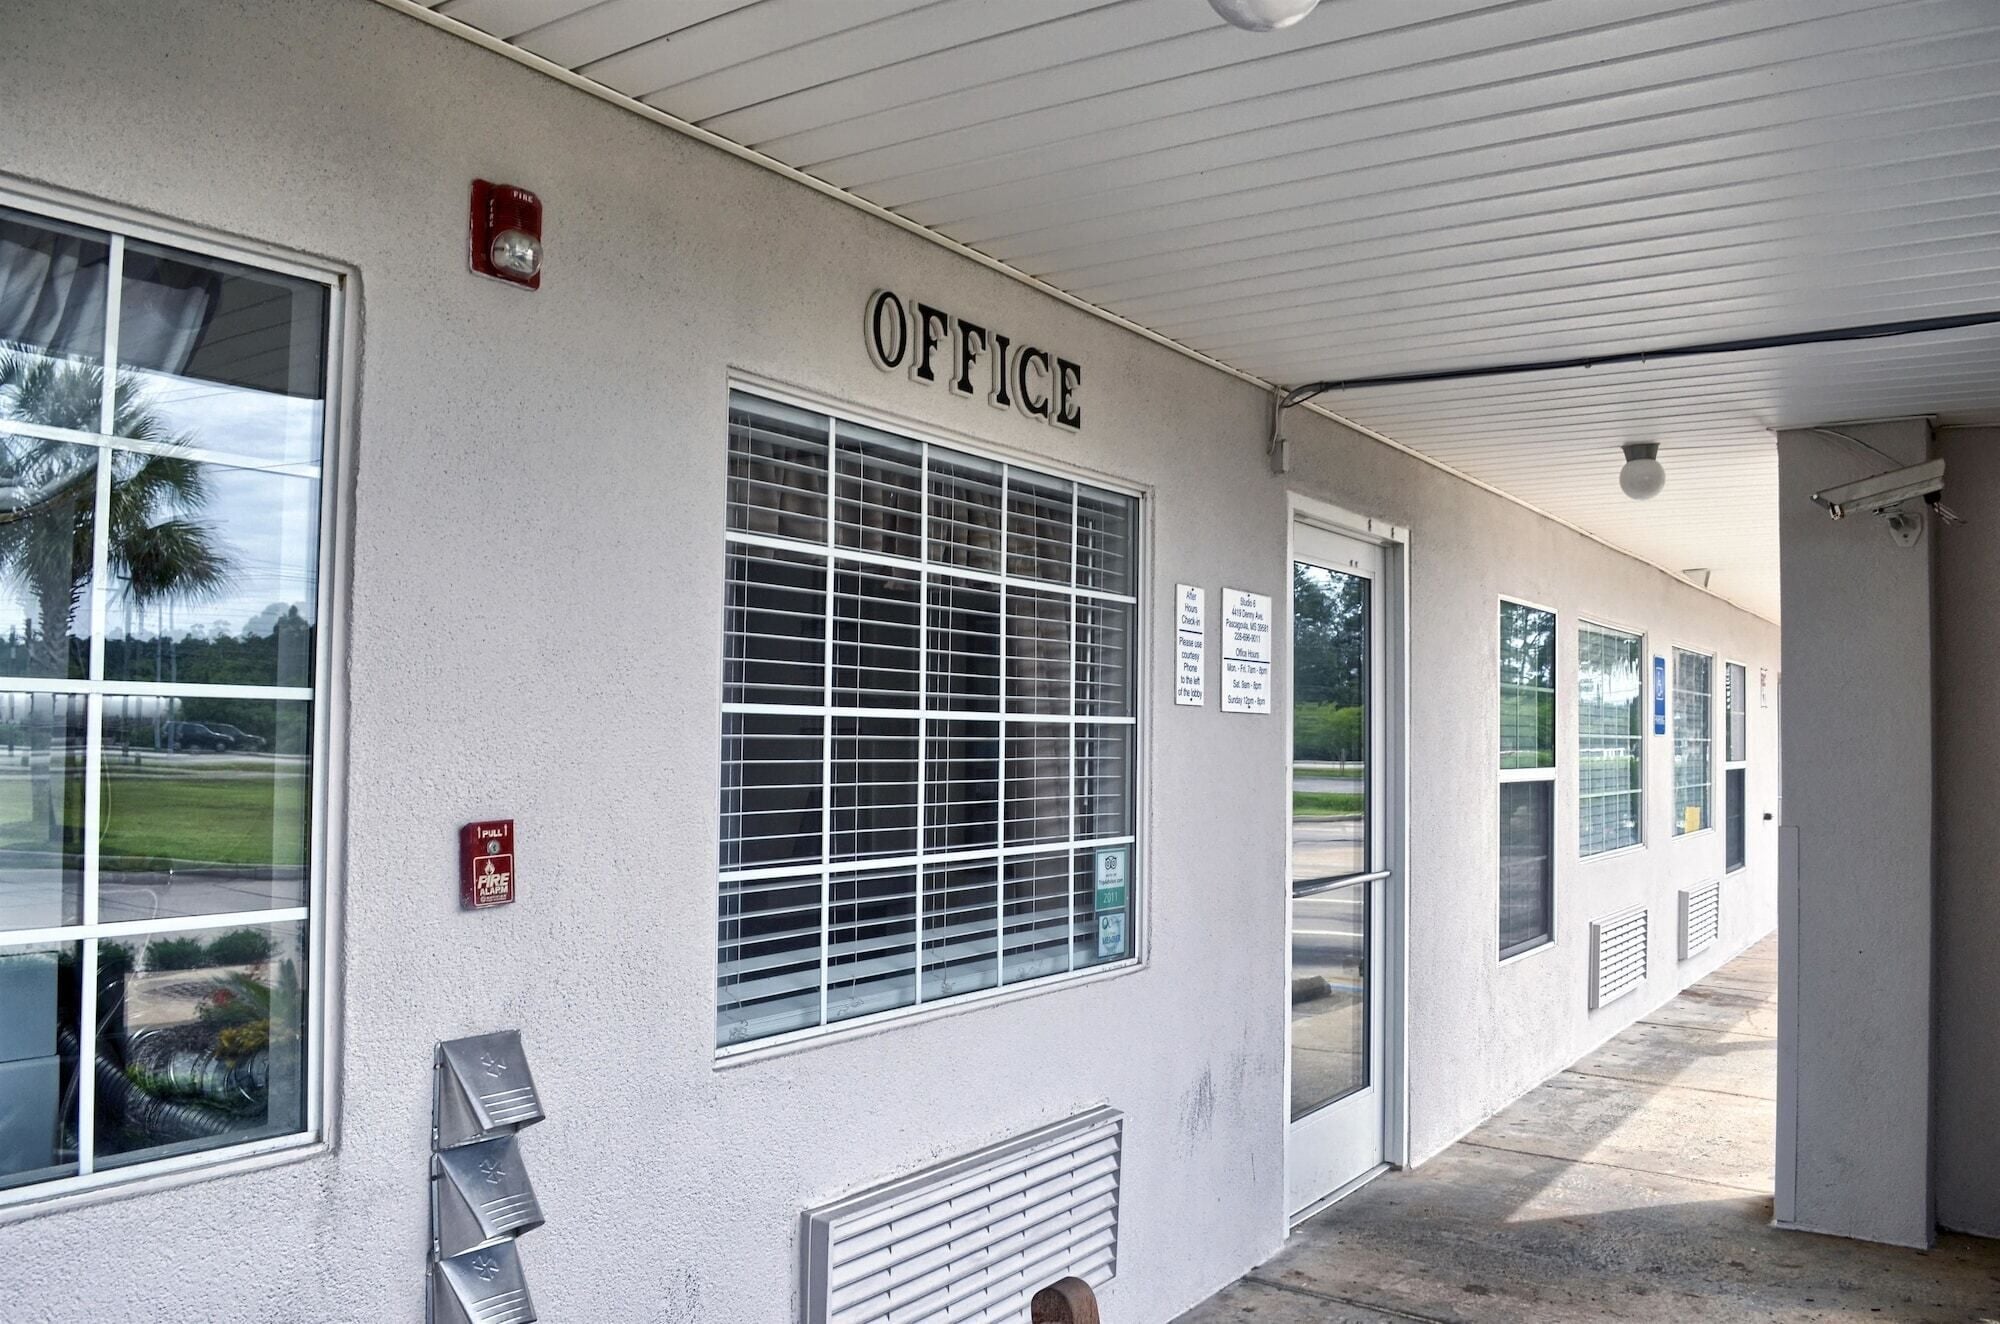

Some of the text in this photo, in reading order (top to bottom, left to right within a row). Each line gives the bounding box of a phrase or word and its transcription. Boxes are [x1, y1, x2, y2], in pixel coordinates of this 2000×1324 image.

[513, 190, 533, 203] FIRE
[867, 290, 1081, 431] OFFICE
[1186, 591, 1196, 601] After
[1240, 597, 1252, 607] Studio
[1185, 603, 1198, 614] Hours
[1232, 608, 1242, 617] 4419
[1242, 610, 1254, 621] Denny
[1182, 615, 1200, 627] Check-in
[1226, 619, 1249, 632] Pascagoula,
[1179, 636, 1194, 647] Please
[1182, 650, 1199, 662] courtesy
[1236, 648, 1259, 659] Office Hours
[1184, 662, 1198, 673] Phone
[1227, 663, 1237, 672] Mon.
[1247, 665, 1256, 674] 7am
[1191, 688, 1202, 700] lobby
[1228, 695, 1242, 706] Sunday
[1243, 696, 1254, 706] 12pm
[482, 829, 502, 838] PULL
[478, 872, 510, 889] FIRE
[480, 886, 508, 896] ALARM
[1104, 892, 1118, 904] 2011
